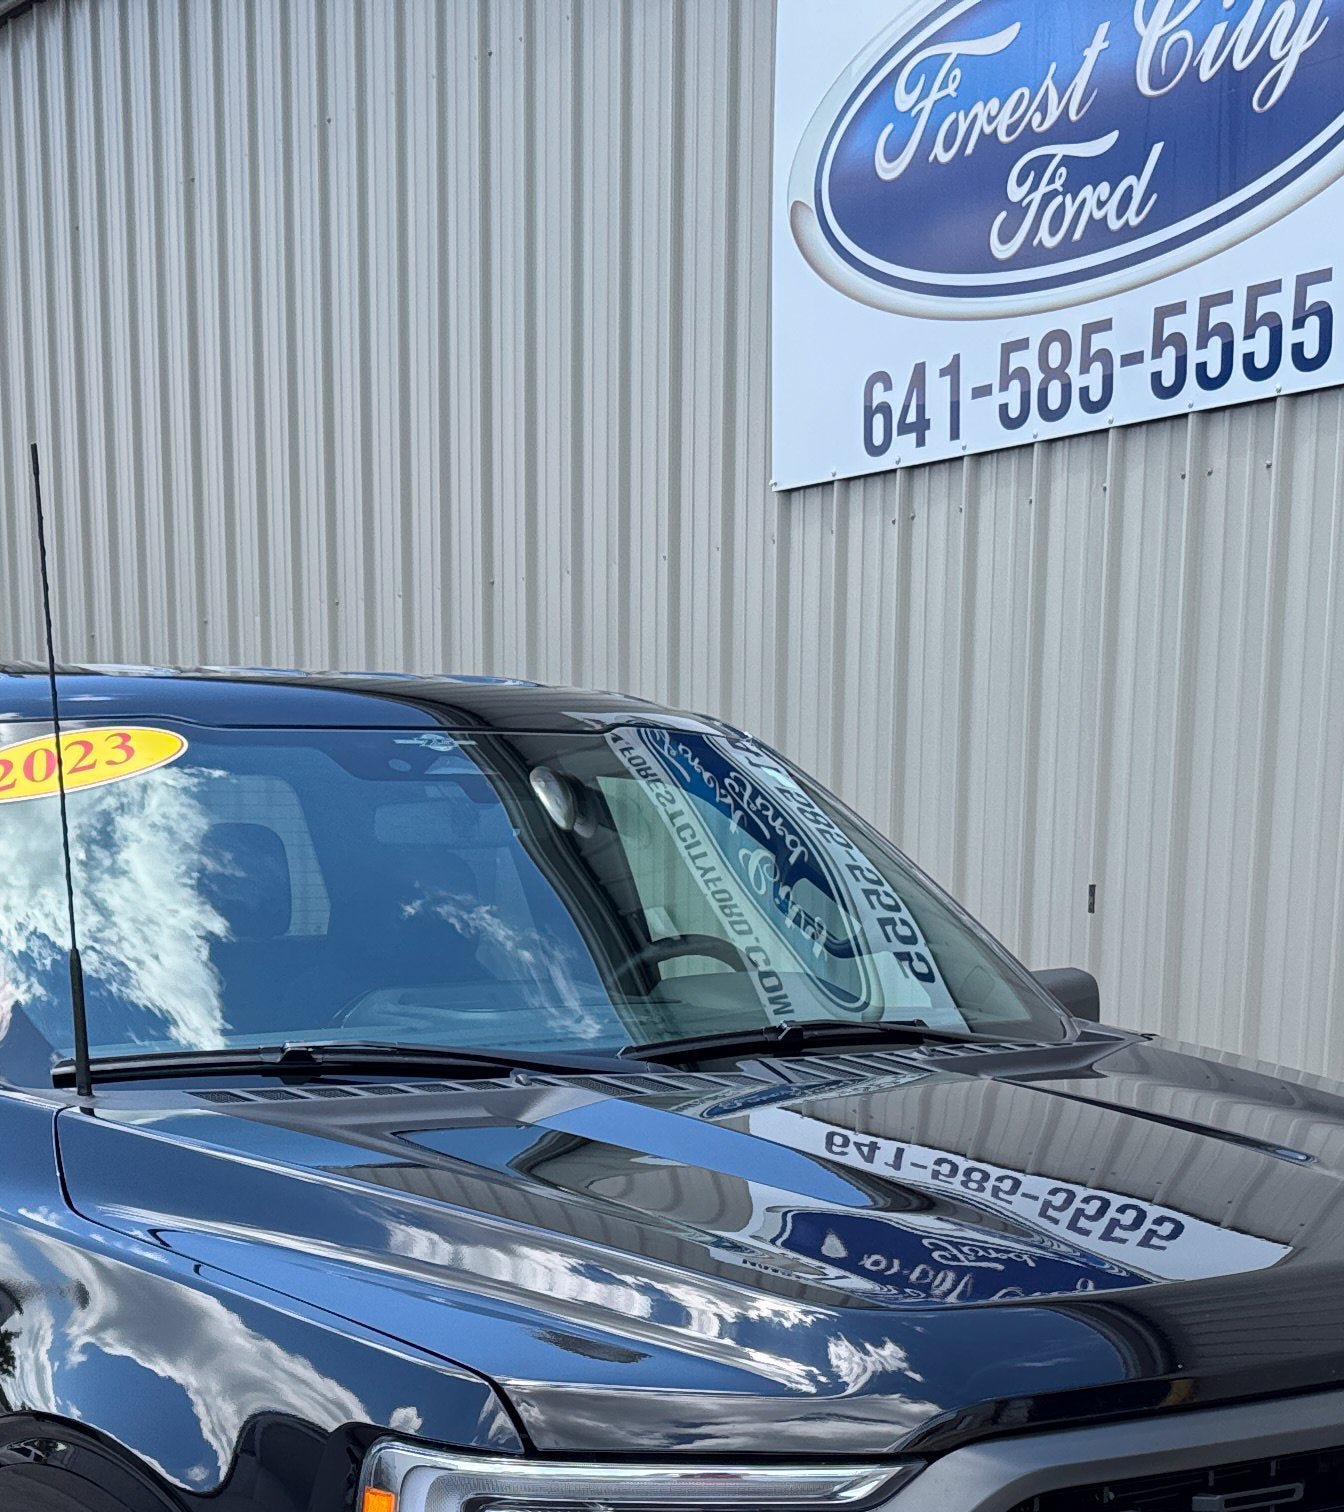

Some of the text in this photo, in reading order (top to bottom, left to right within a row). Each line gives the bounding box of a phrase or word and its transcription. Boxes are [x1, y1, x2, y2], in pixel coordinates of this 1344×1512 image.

[874, 0, 1330, 182] Forest City
[989, 129, 1165, 261] Ford
[862, 267, 1335, 459] 641-585-5555
